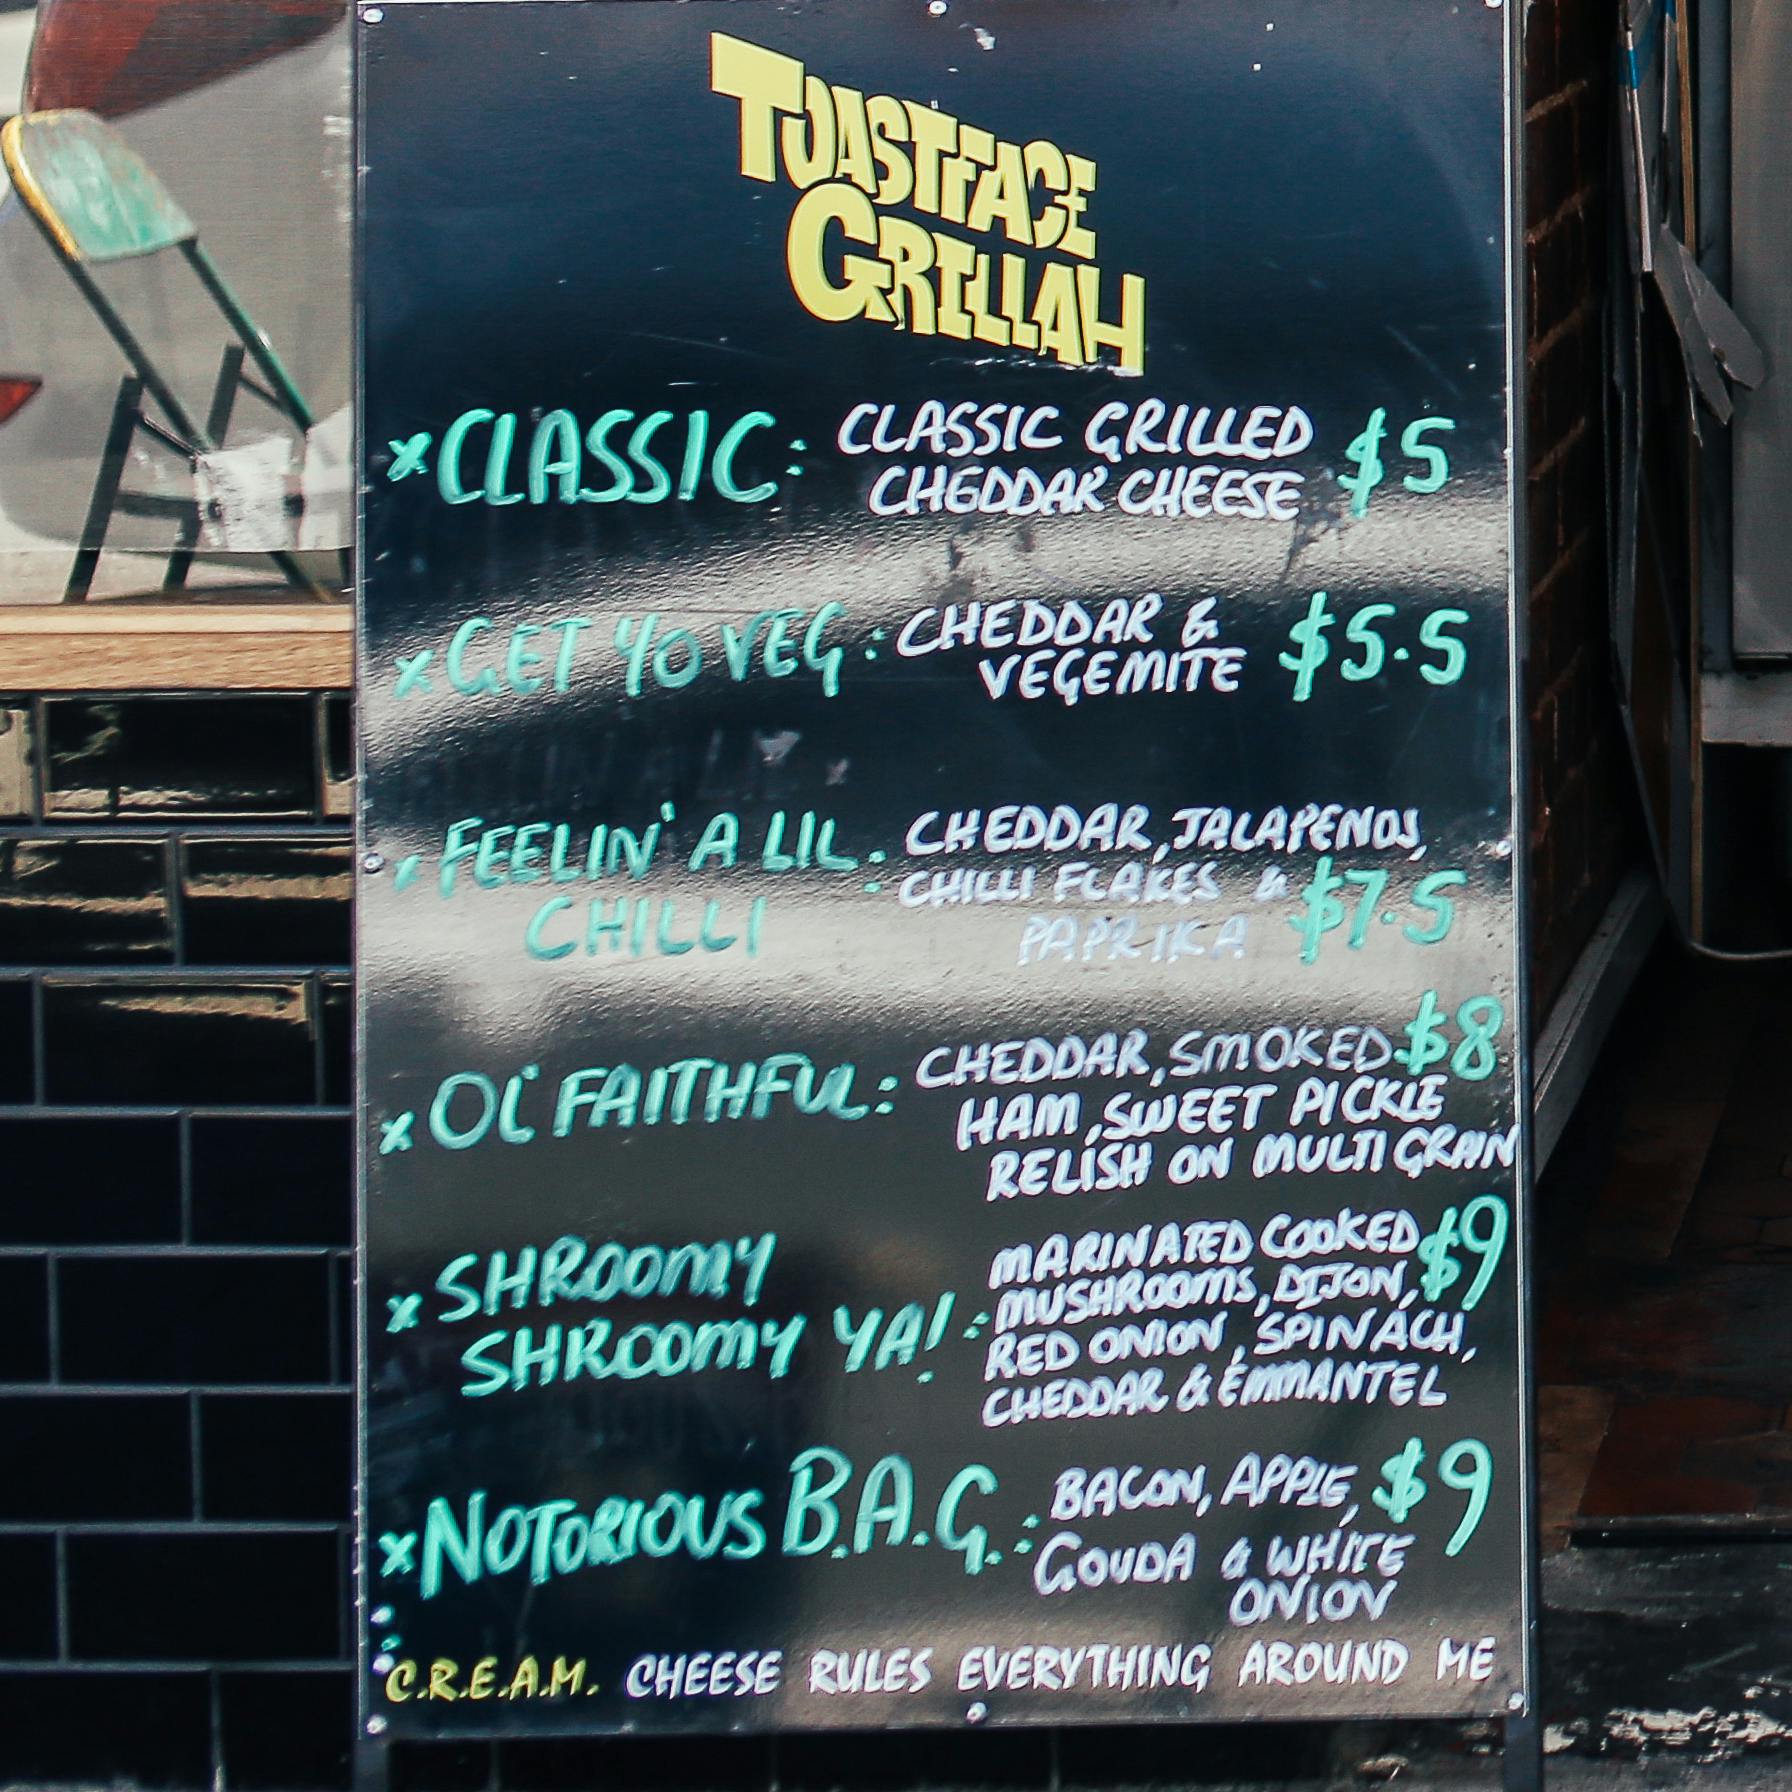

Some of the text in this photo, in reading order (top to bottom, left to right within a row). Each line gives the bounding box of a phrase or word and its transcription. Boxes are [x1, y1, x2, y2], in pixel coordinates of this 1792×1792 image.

[709, 30, 1099, 262] TOASTFACE
[787, 181, 1146, 377] GRILLAH
[438, 401, 1456, 519] CLASSIC: CLASSIC GRILLED $5
[868, 468, 1303, 521] CHEDDAR CHEESE
[978, 648, 1245, 704] VEGEMITE
[525, 893, 765, 961] CHILLI
[1396, 988, 1506, 1083] $8
[435, 1195, 1509, 1324] SHROOMY $9
[460, 1314, 805, 1398] SHROOMY
[421, 1437, 1496, 1600] NOTORIOUS $9
[385, 1632, 1497, 1705] C.R.E.A.M. CHEESE RULES EVERYTHING AROUND ME
